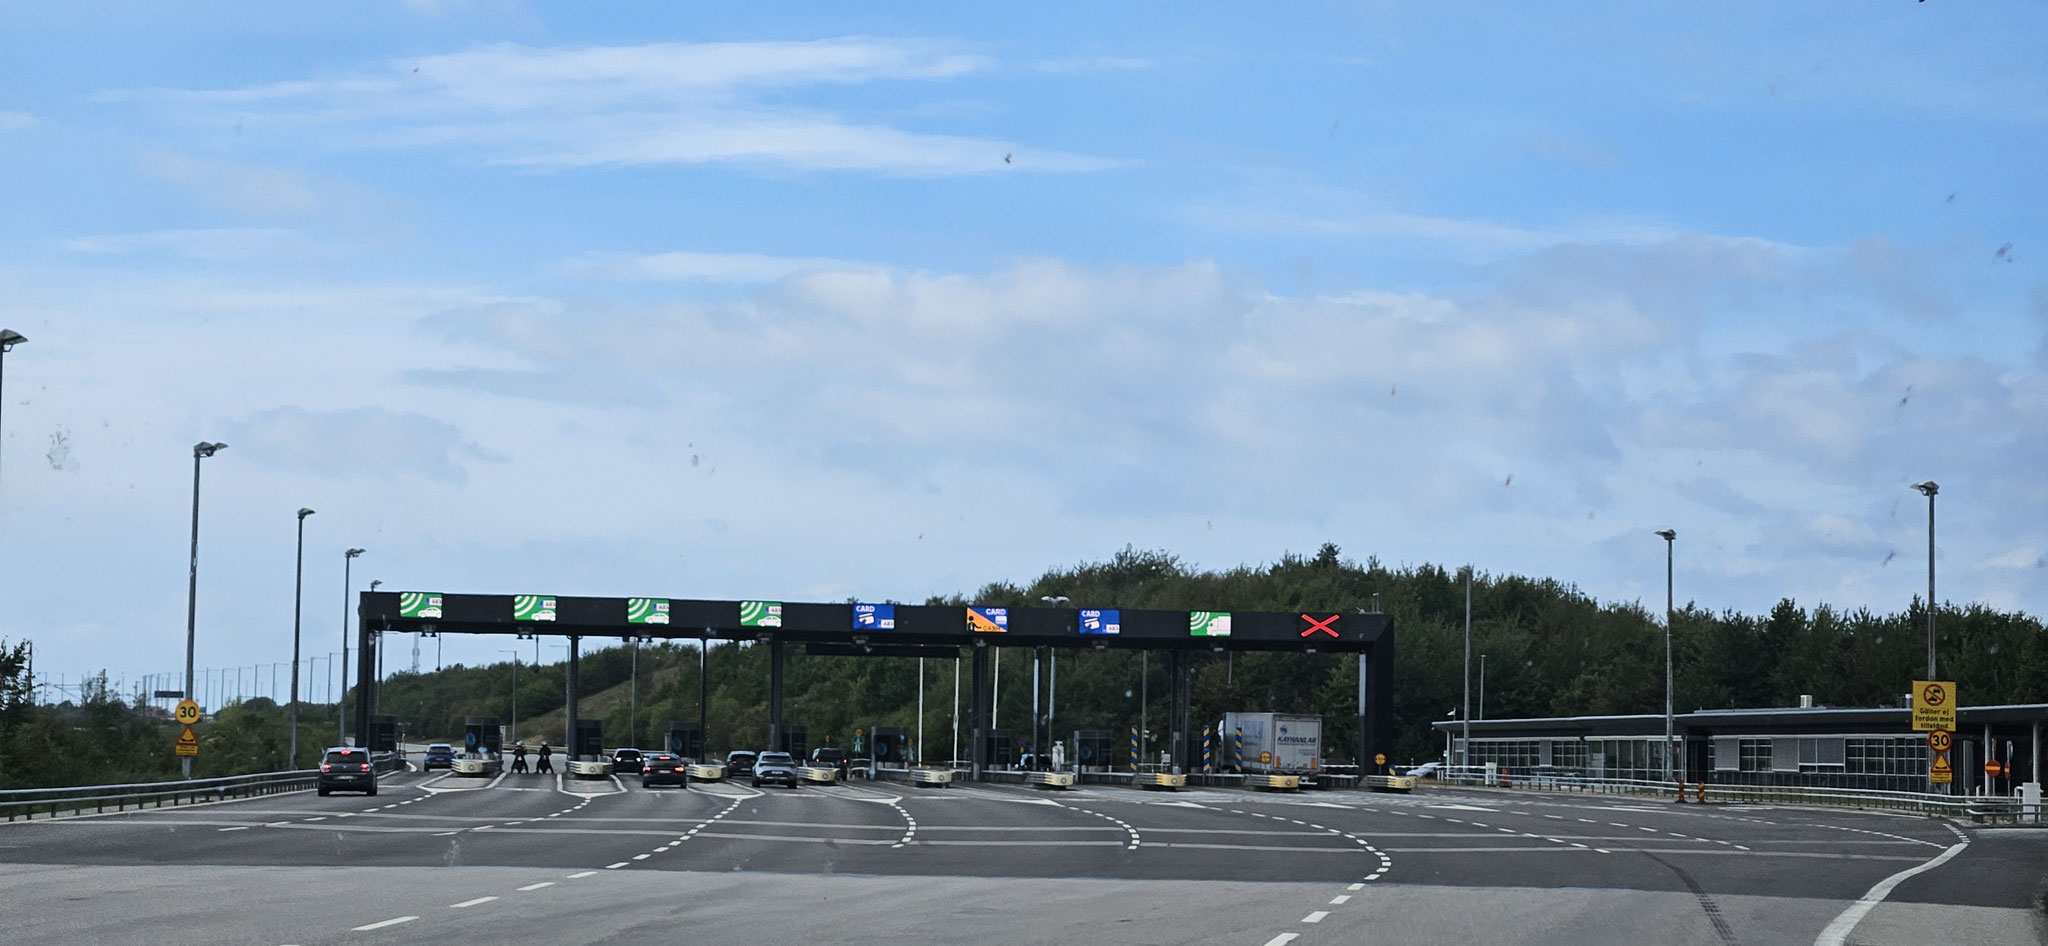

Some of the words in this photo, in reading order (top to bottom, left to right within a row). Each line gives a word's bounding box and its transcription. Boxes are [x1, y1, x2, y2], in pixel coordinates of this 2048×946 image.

[856, 605, 875, 613] CARD
[985, 608, 1006, 616] CARD
[1081, 610, 1101, 618] CARD
[179, 706, 197, 718] 30
[1919, 707, 1941, 715] Gäller
[1942, 708, 1950, 716] ej
[1932, 734, 1950, 747] 30
